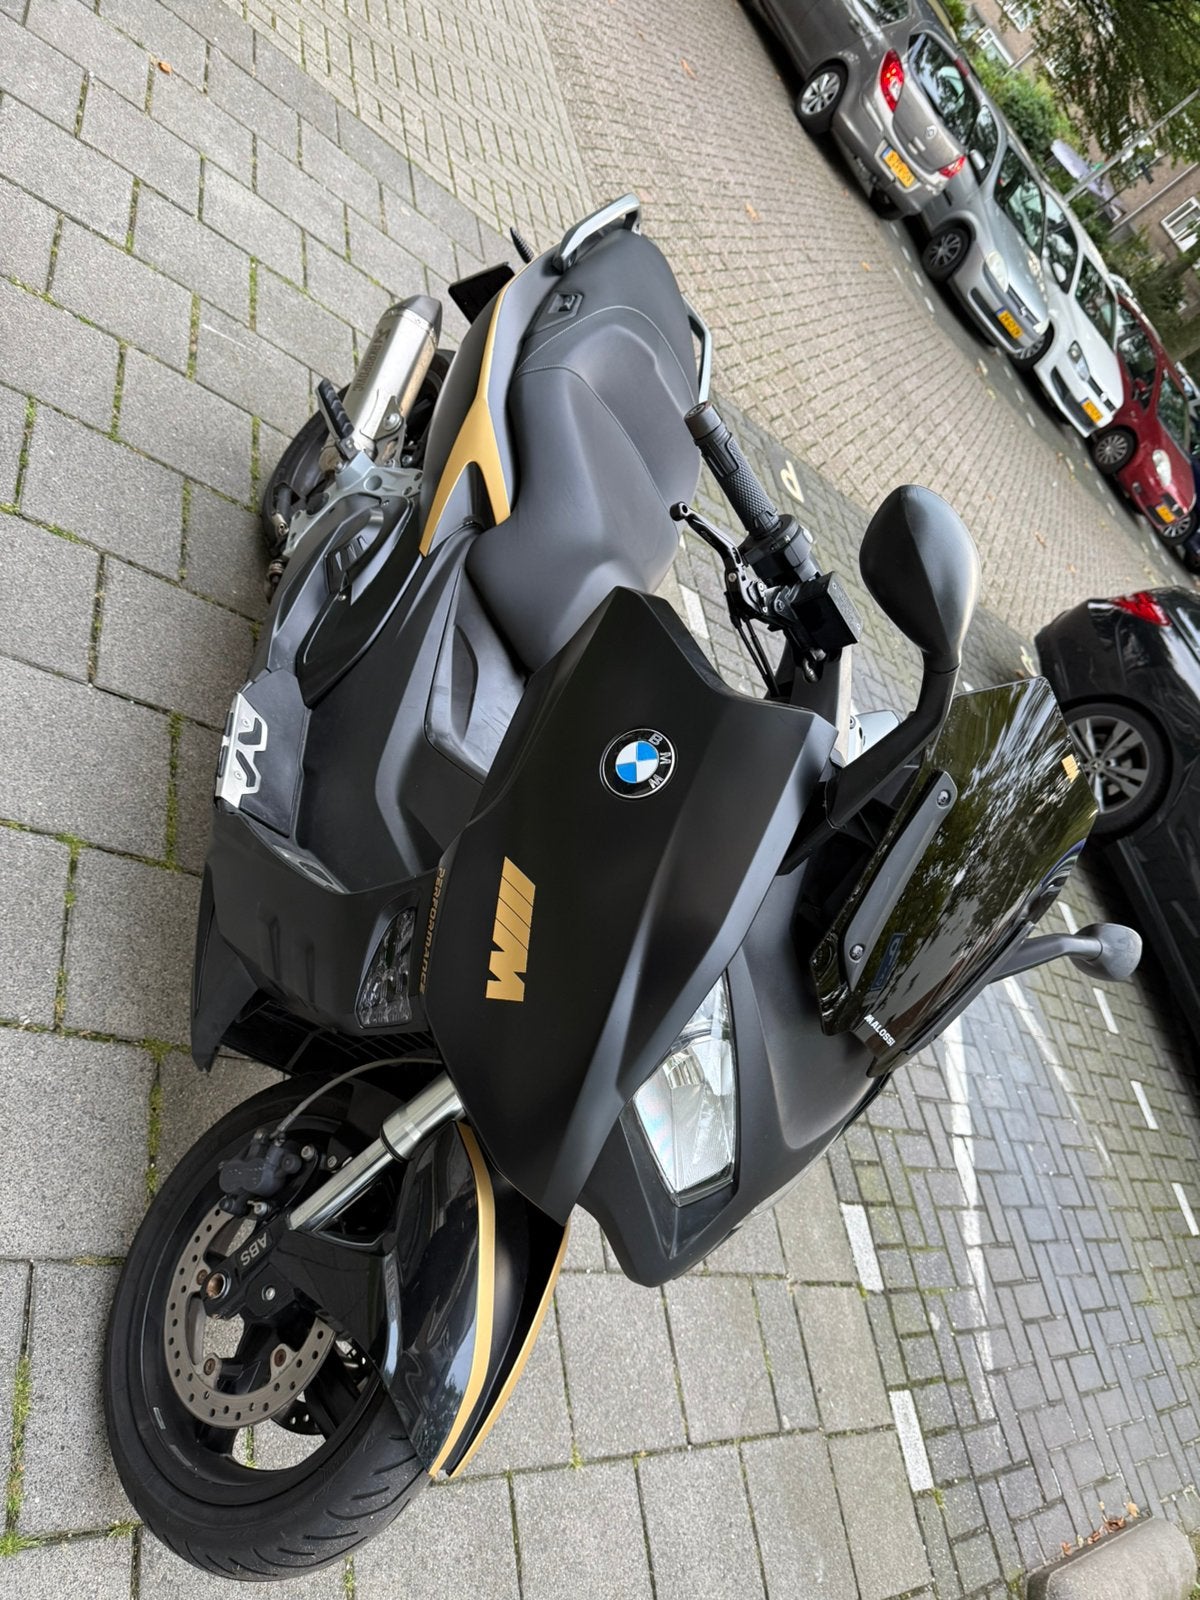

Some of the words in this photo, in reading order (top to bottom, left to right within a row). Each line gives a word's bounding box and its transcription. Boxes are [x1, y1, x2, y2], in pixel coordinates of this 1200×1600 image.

[648, 732, 672, 789] BMW
[419, 867, 446, 995] PERFORMANCE
[864, 1014, 896, 1047] MALOSSI
[240, 1232, 267, 1266] ABS
